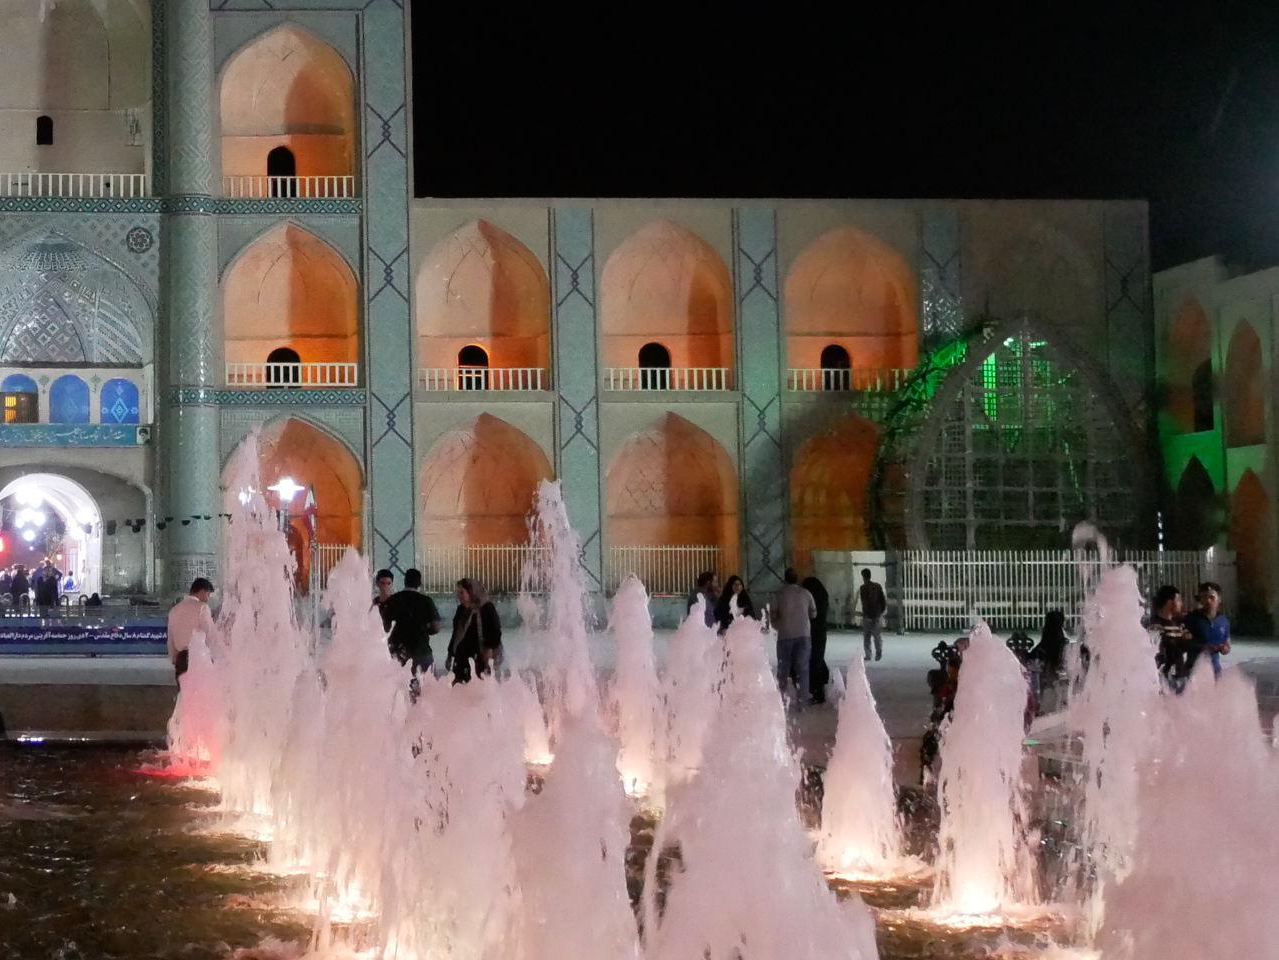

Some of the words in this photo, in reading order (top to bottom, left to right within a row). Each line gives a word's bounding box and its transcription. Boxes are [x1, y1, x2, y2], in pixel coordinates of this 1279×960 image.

[94, 632, 110, 640] مقدس
[110, 632, 122, 640] دفاع
[122, 632, 131, 640] سال
